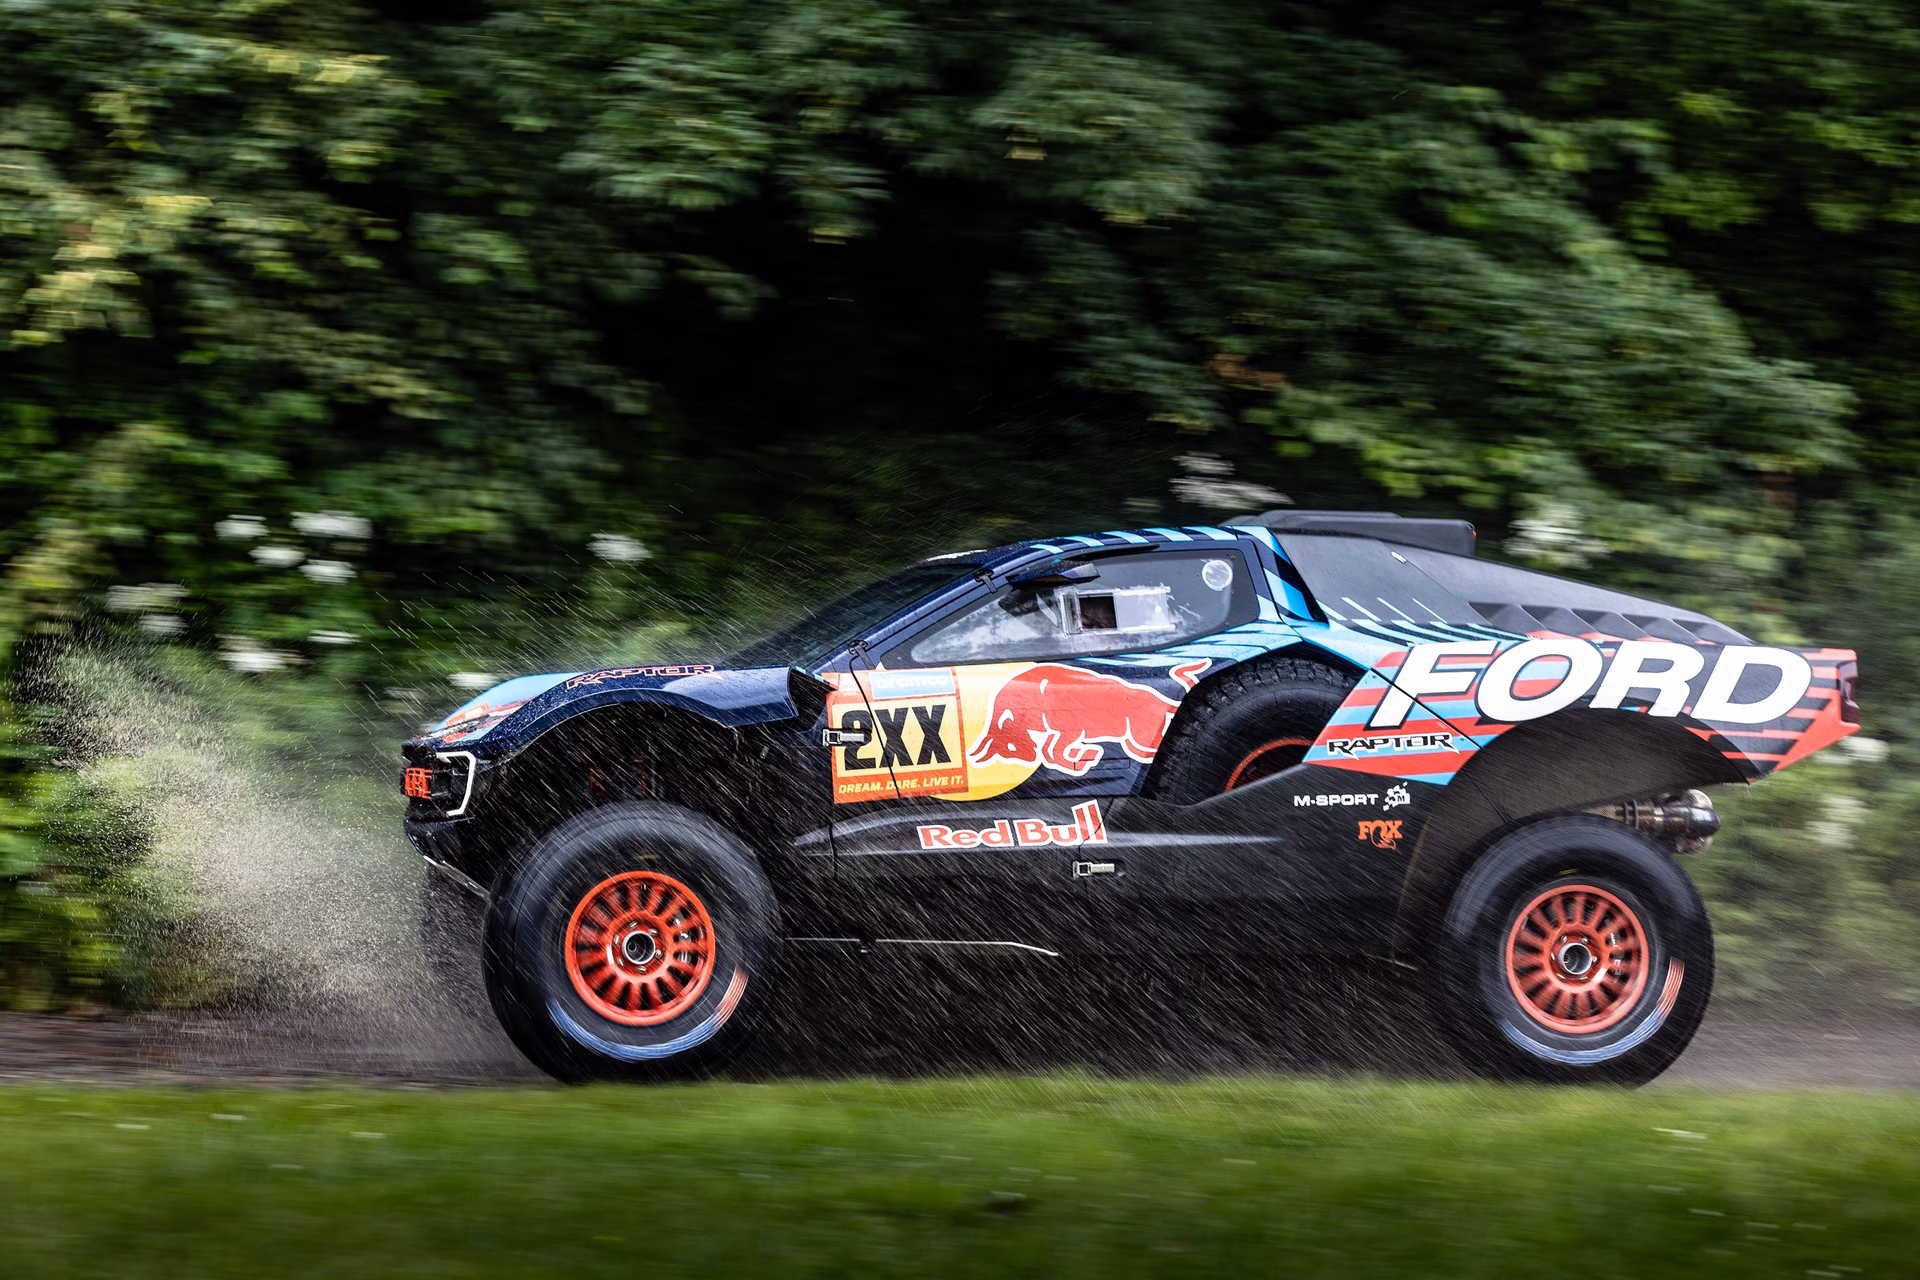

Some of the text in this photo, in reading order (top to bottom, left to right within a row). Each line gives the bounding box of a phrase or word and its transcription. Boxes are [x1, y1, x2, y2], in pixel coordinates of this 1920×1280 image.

[566, 664, 724, 690] RAPTOR
[876, 675, 948, 689] aramco
[1368, 639, 1812, 728] FORD
[841, 704, 952, 771] 2XX
[1326, 732, 1460, 760] RAPTOR
[838, 775, 964, 794] DREAM. DARE. LIVE IT.
[917, 799, 1107, 849] Red Bull
[1357, 819, 1403, 843] FOX
